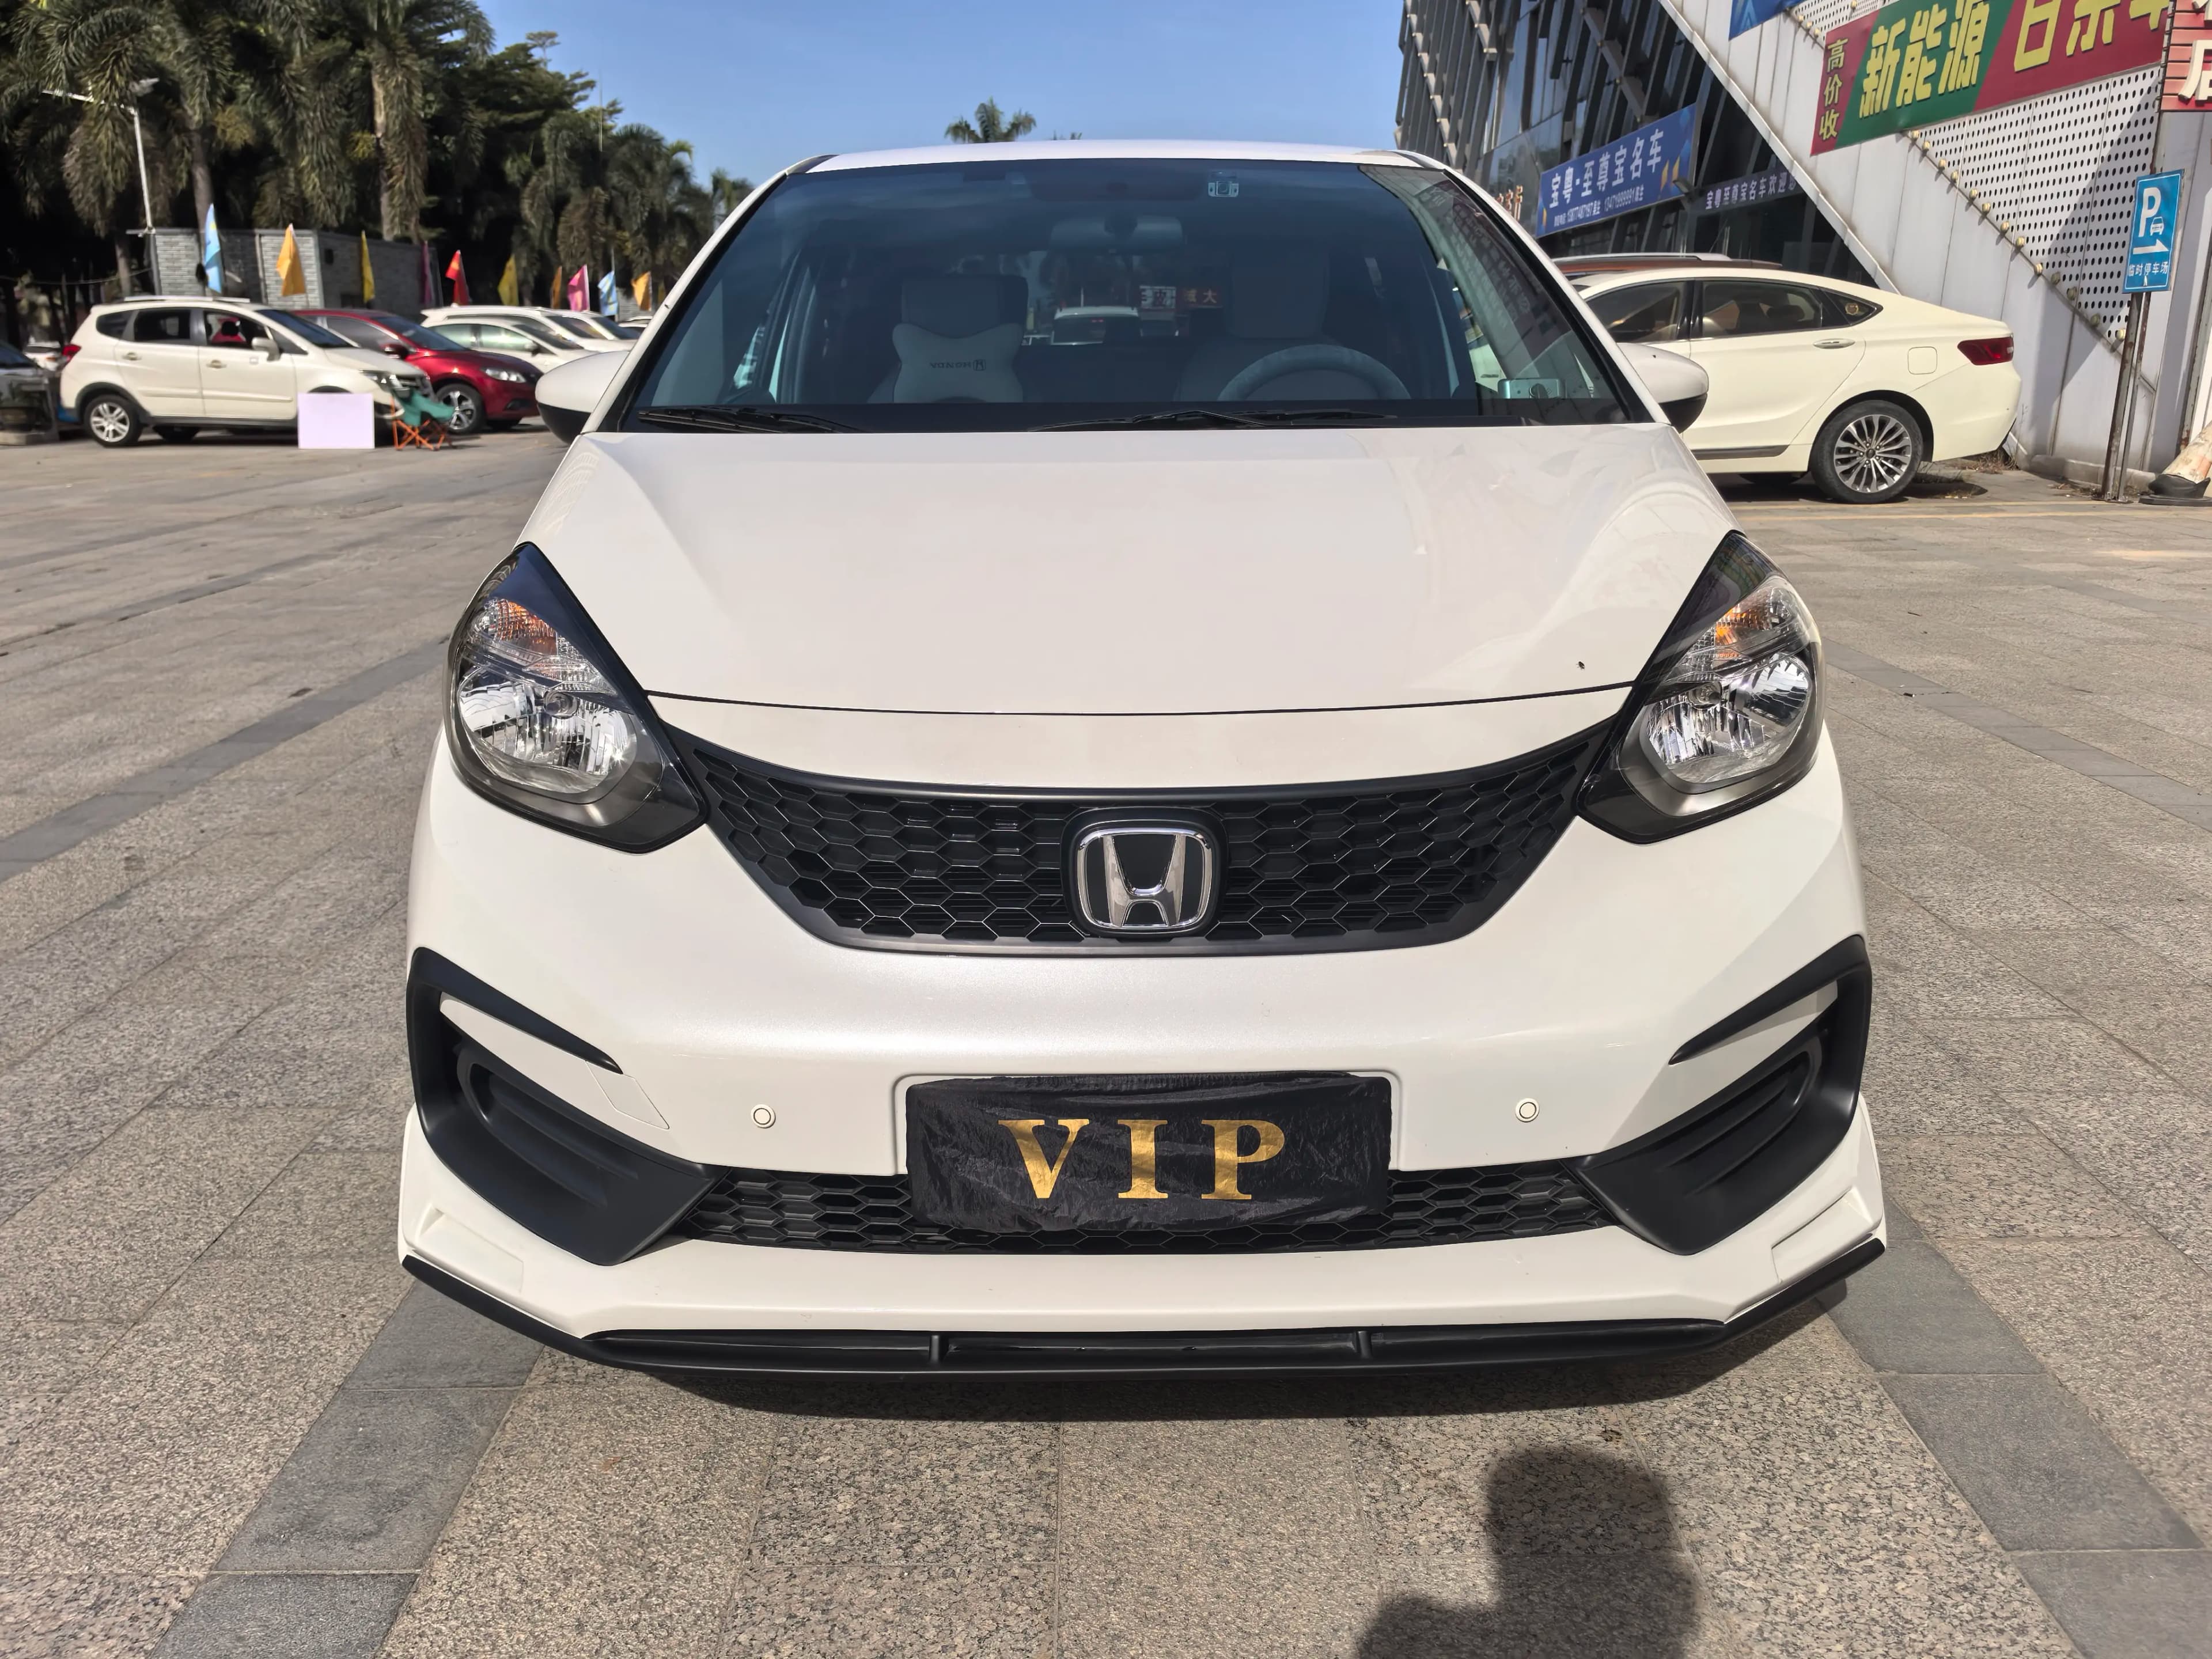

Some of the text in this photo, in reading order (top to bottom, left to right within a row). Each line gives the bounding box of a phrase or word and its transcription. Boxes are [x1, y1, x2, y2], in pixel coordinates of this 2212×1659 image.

[1819, 38, 1848, 141] 高价收
[1859, 0, 1990, 119] 新能源
[2138, 187, 2161, 237] P
[2128, 261, 2168, 276] 临时停车场
[997, 1118, 1285, 1200] VIP
